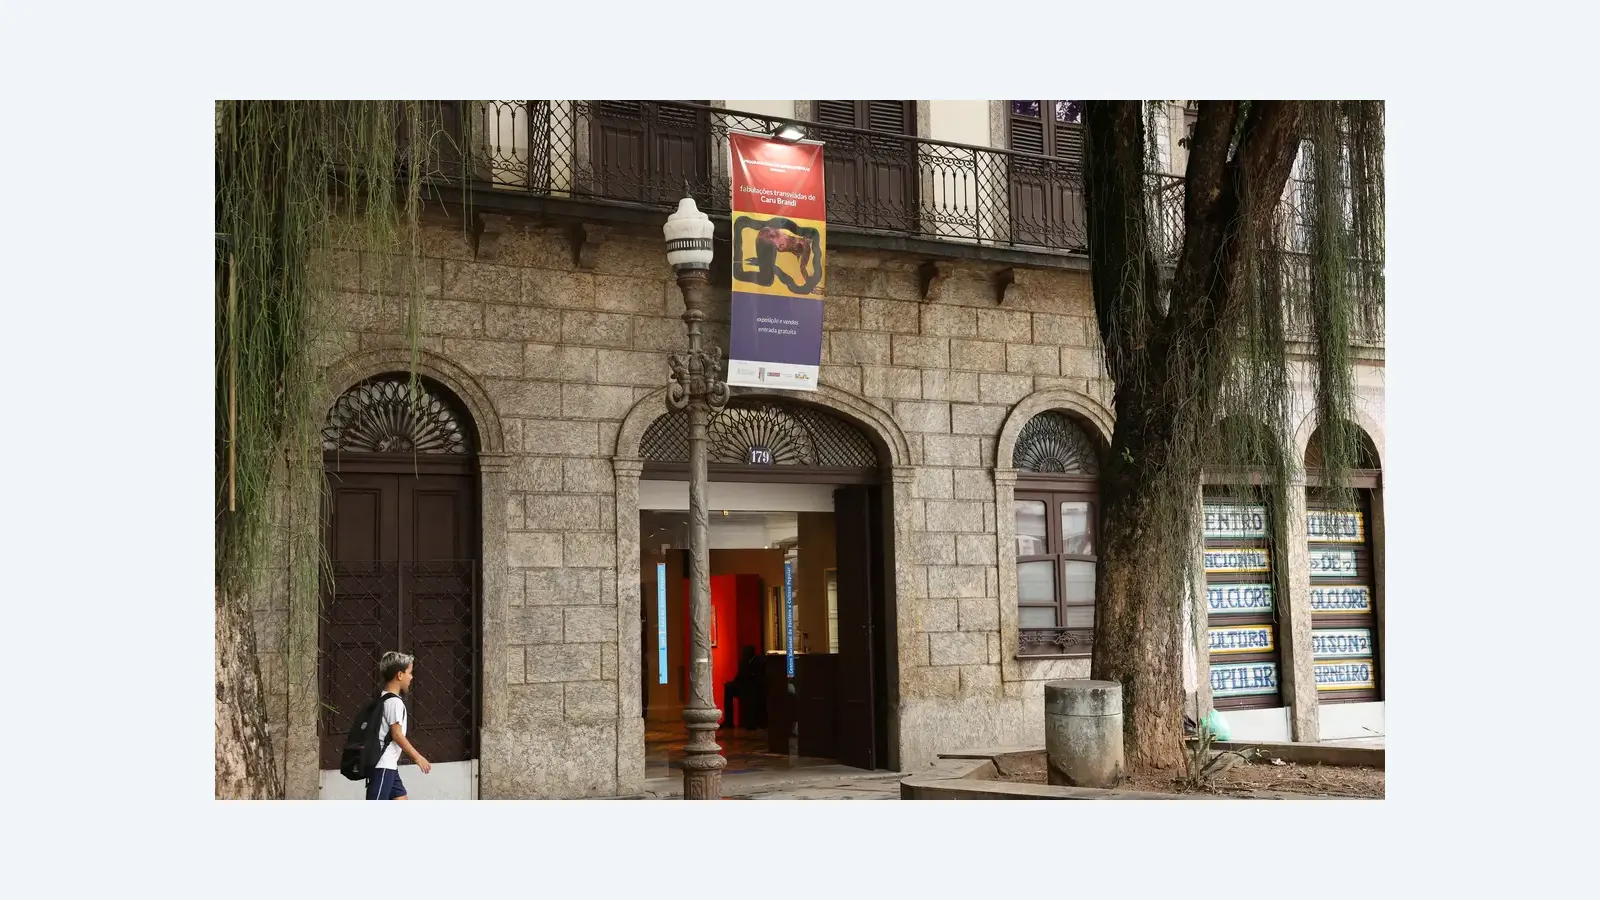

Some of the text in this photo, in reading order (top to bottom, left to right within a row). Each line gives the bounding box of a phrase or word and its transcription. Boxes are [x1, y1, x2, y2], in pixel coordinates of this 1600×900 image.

[740, 185, 773, 195] fabulações
[774, 190, 807, 200] transviadas
[760, 195, 797, 207] Caru Brandi
[778, 328, 797, 336] gratuita
[752, 450, 769, 464] 179
[1204, 513, 1262, 531] ENTRO
[1204, 553, 1266, 568] ACIONAL
[1207, 588, 1270, 608] OLCLORE
[1309, 588, 1368, 609] OLCLORE
[1208, 630, 1269, 649] ULTURA
[1312, 635, 1359, 653] DISON
[1210, 667, 1275, 690] OPULAR
